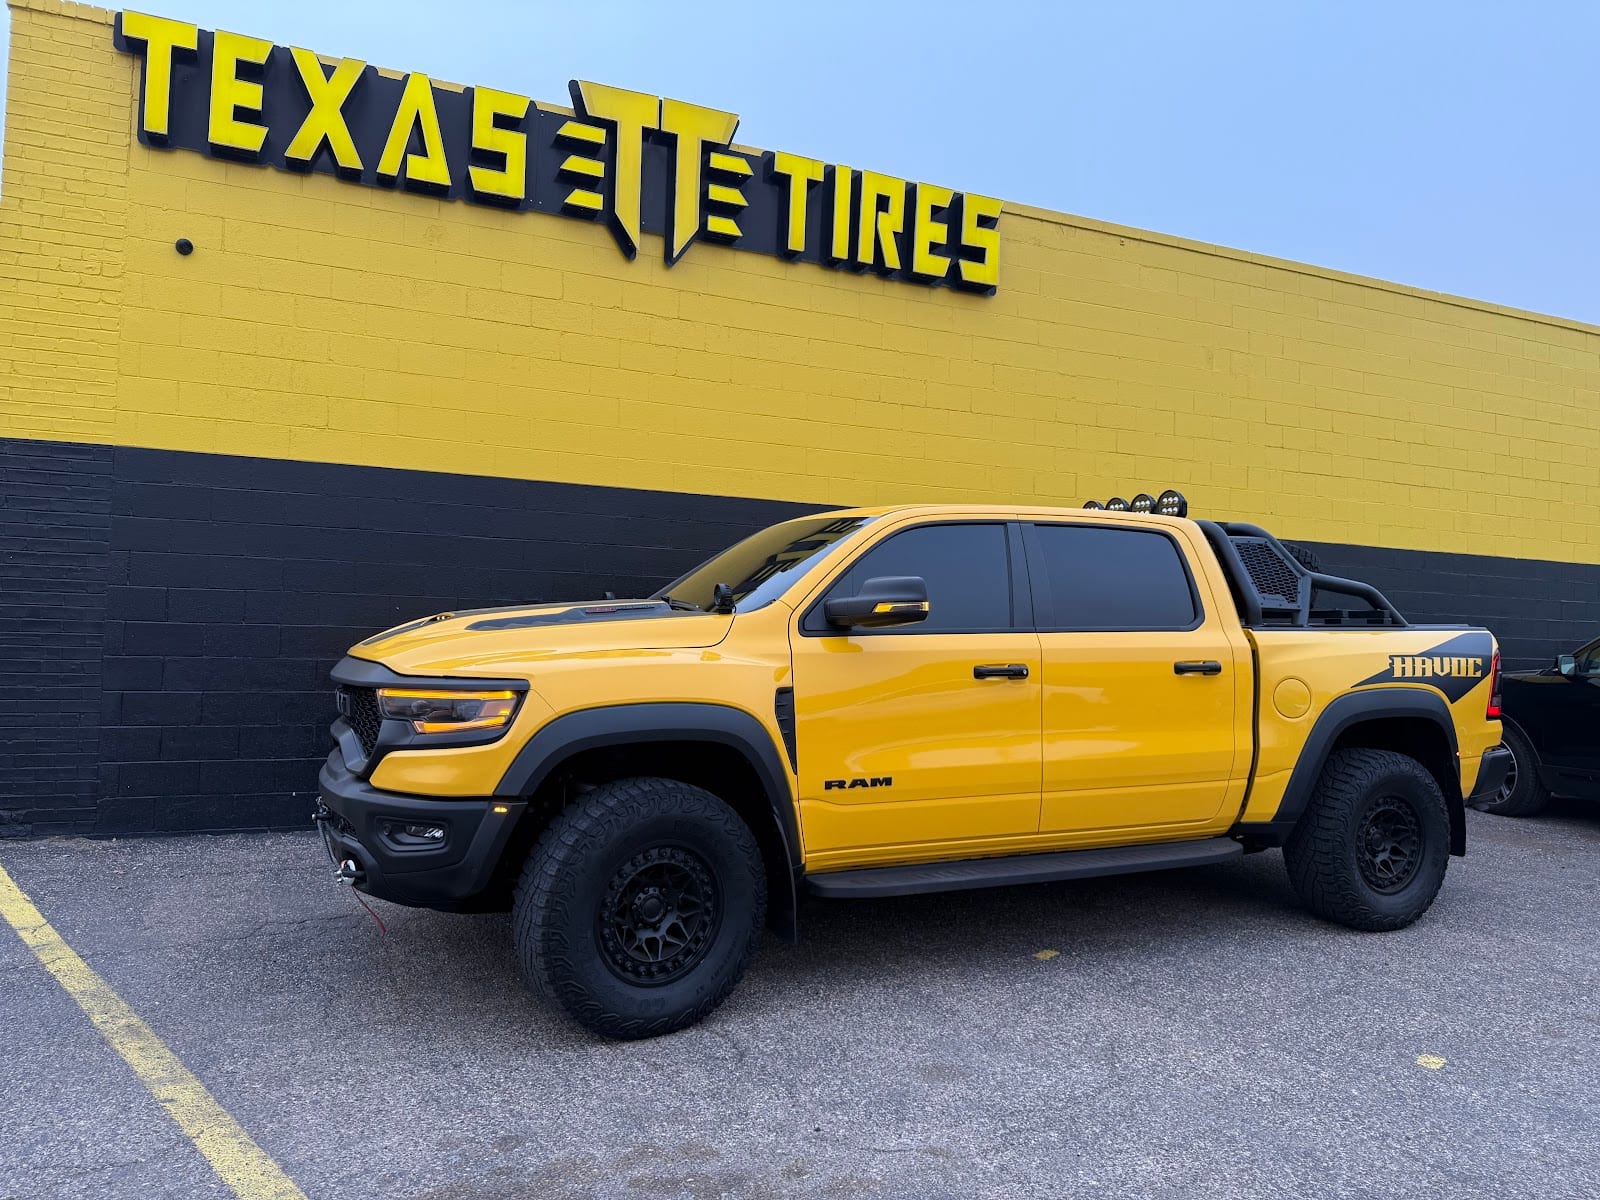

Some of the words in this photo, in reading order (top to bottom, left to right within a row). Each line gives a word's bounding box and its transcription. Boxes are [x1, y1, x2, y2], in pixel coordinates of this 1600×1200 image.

[121, 9, 530, 200] TEXAS
[774, 150, 1004, 287] TIRES
[1391, 656, 1482, 678] HAVOC
[824, 777, 893, 790] RAM
